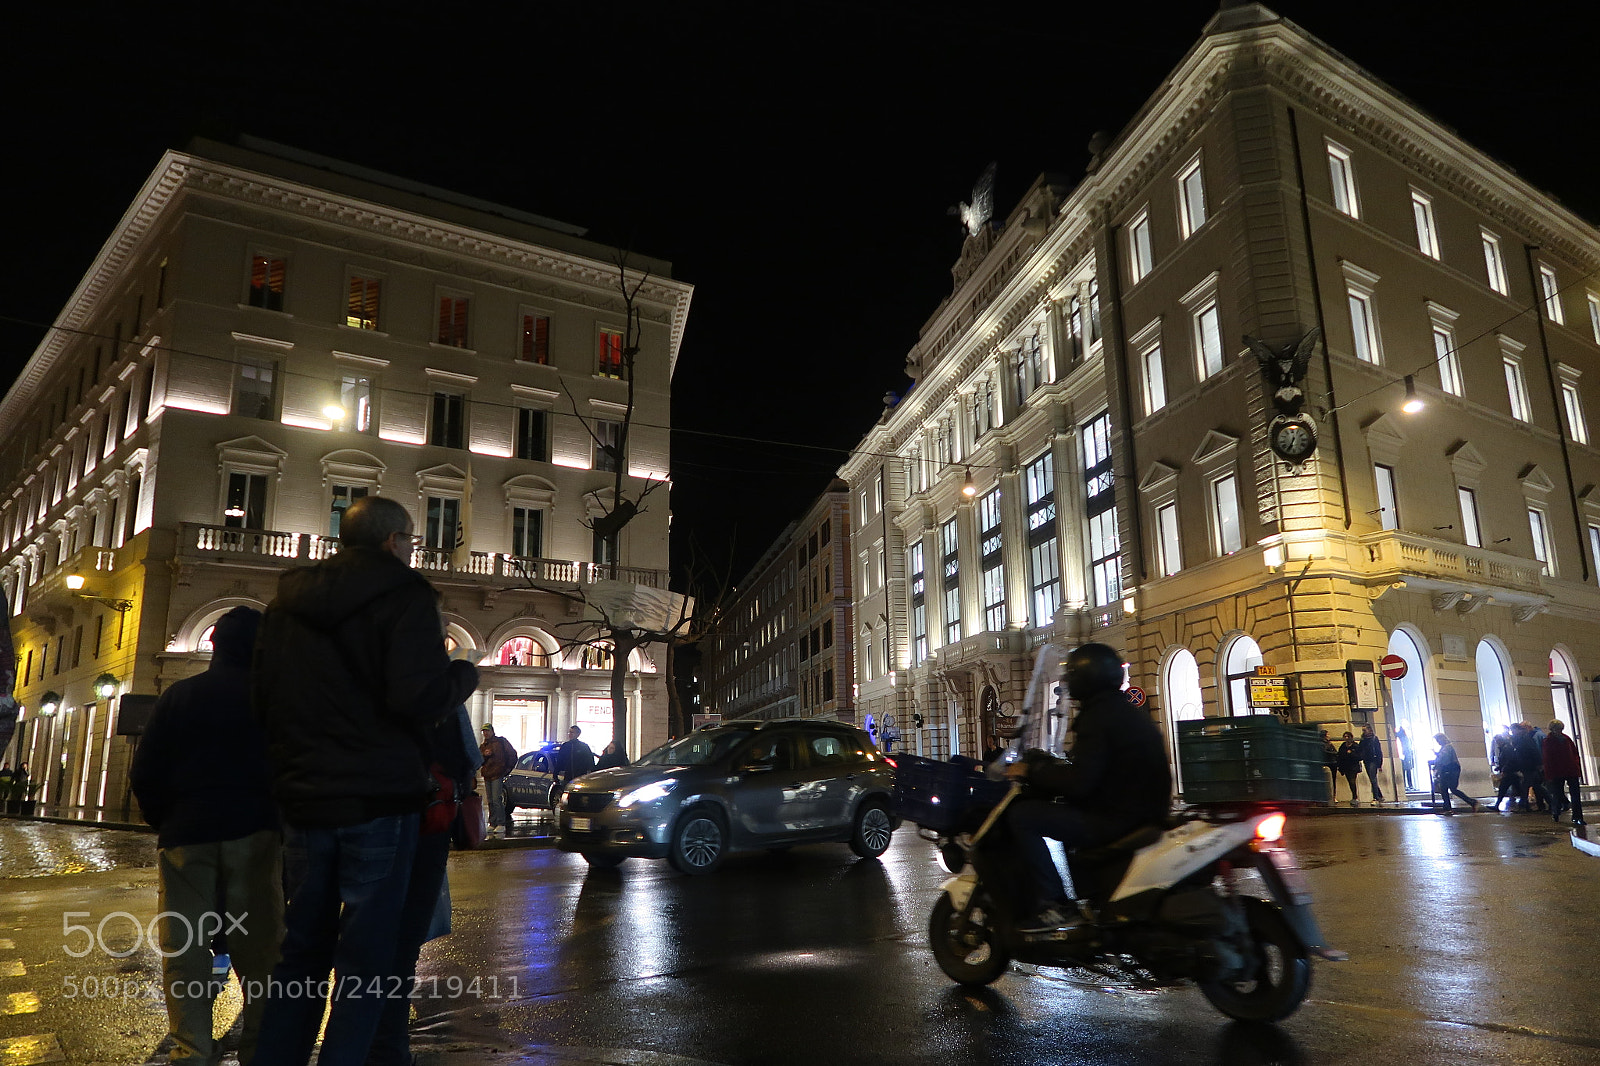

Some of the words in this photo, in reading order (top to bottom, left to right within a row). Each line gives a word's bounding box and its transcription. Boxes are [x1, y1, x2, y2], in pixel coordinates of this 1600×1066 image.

[972, 246, 1020, 312] MILITARE
[1259, 666, 1276, 675] TAXI
[589, 705, 612, 715] FEND
